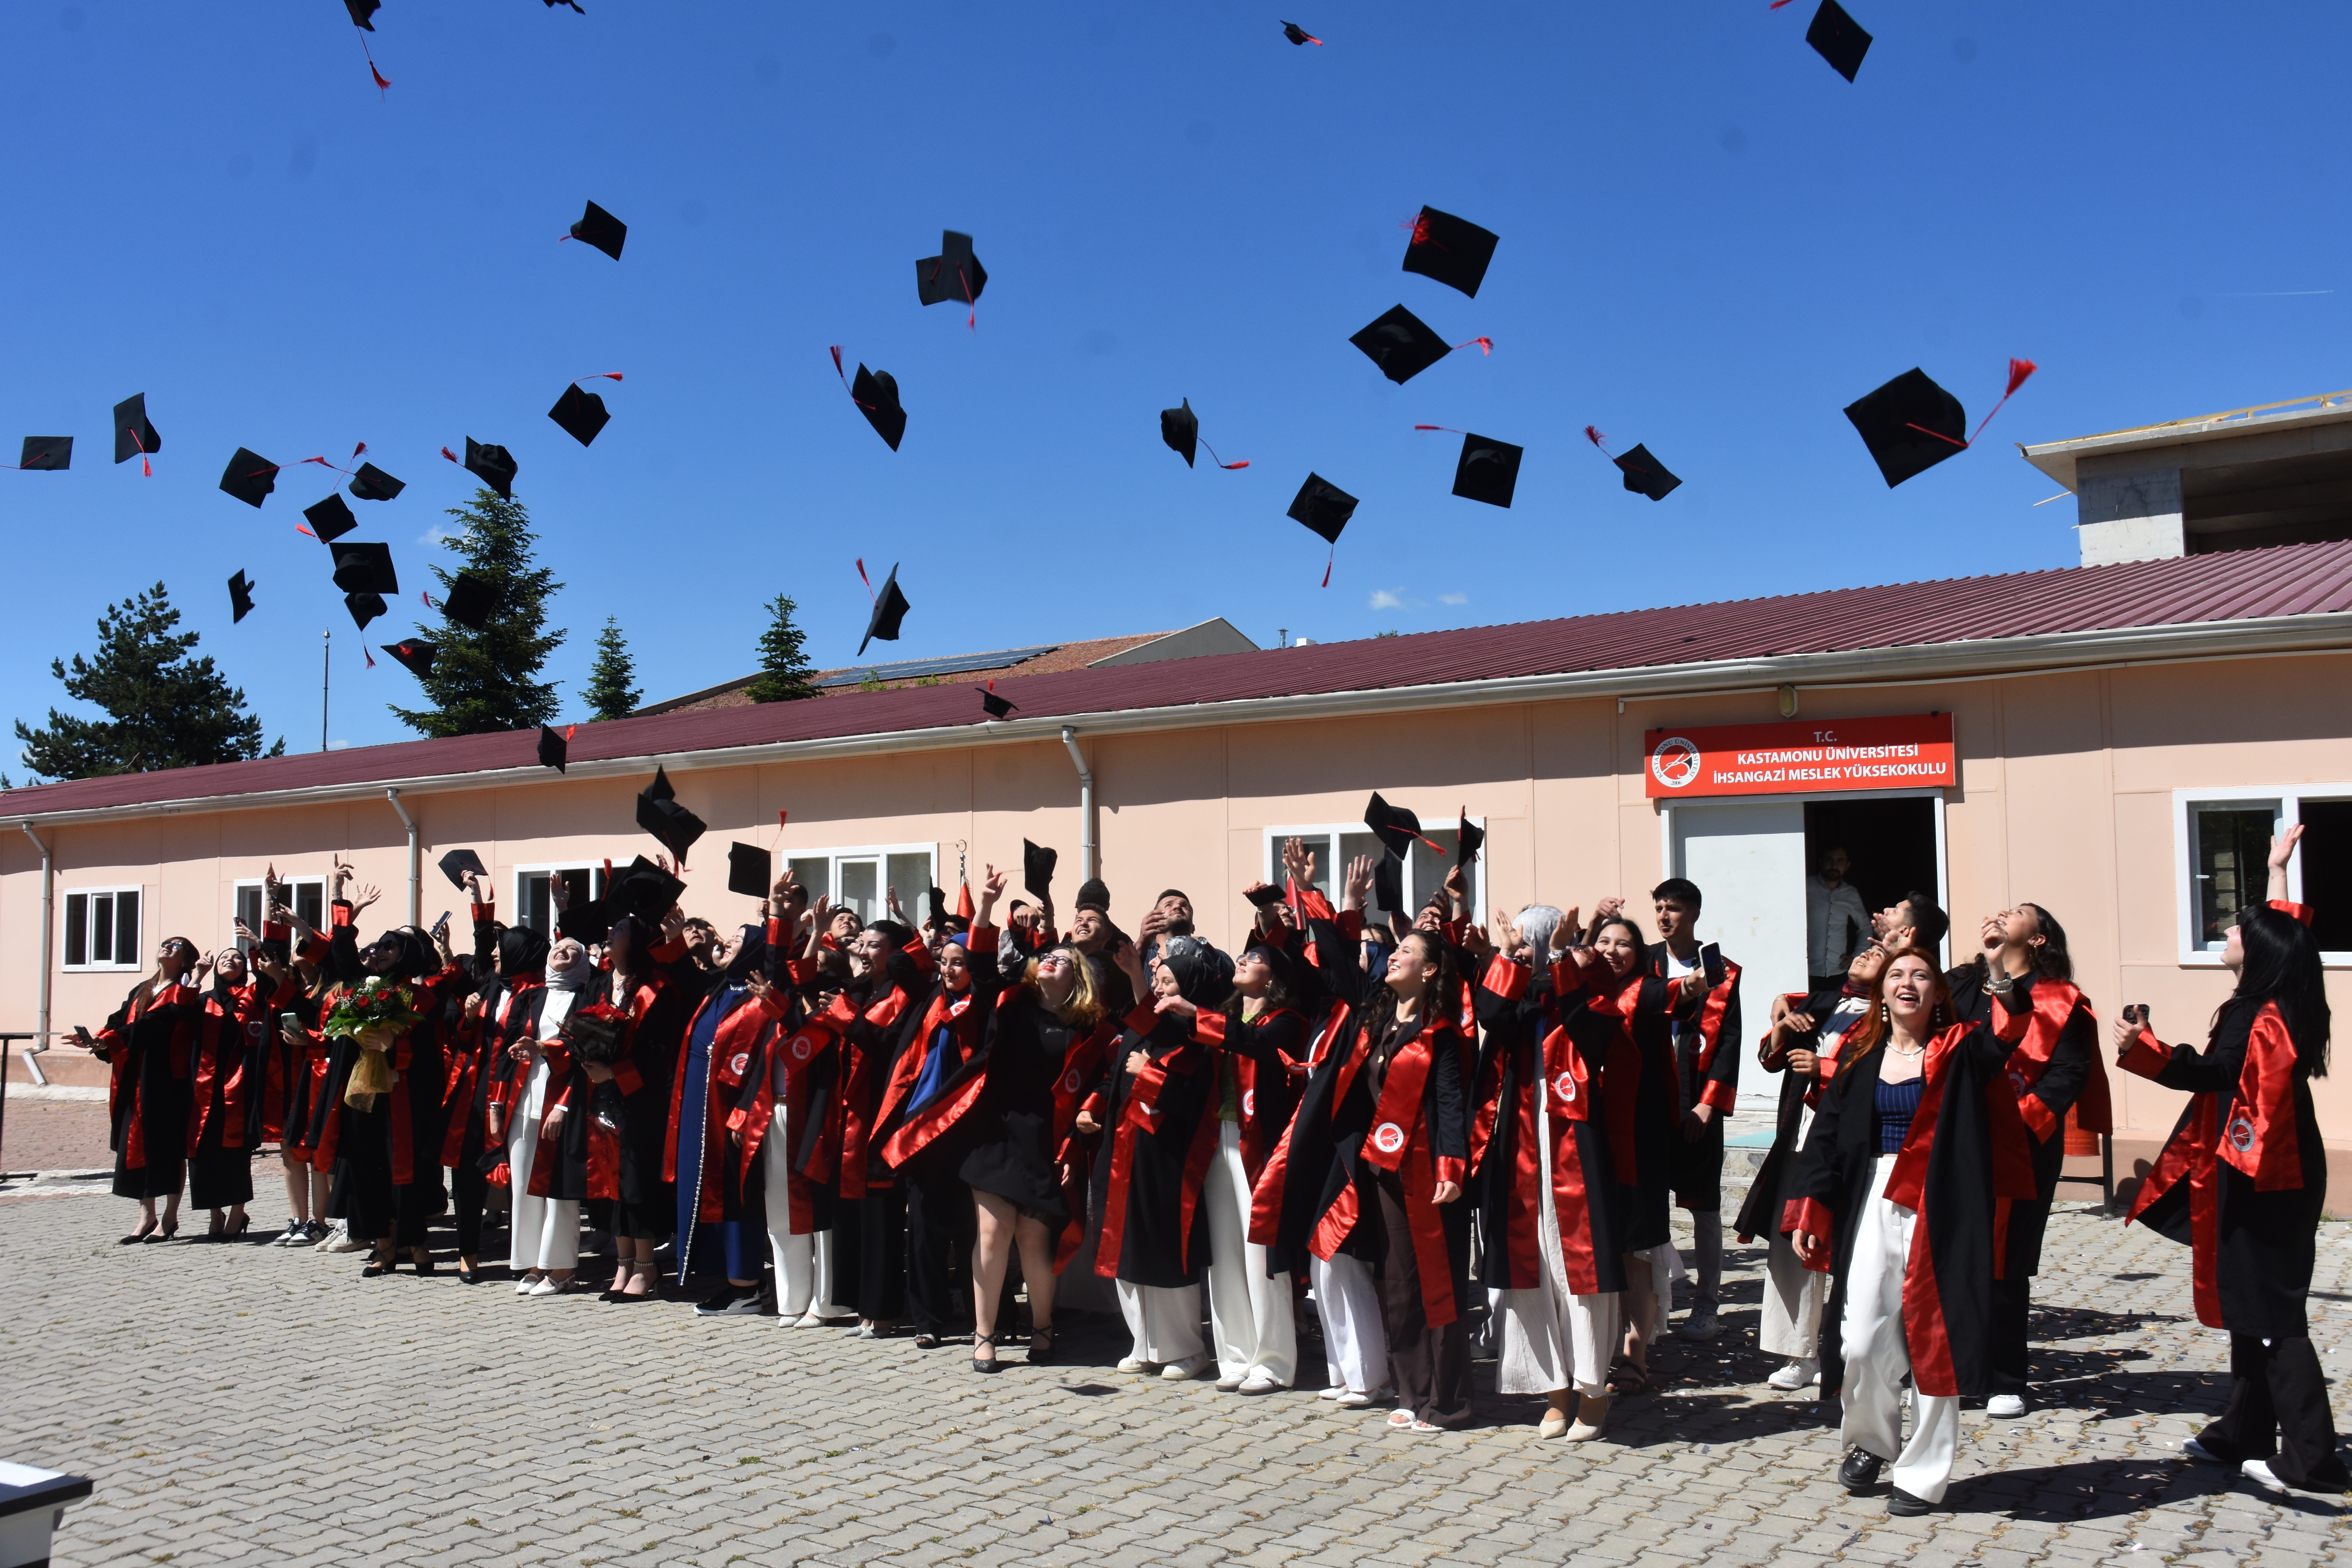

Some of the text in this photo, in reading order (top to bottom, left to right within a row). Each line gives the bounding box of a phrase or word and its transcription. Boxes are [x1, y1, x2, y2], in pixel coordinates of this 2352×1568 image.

[1814, 731, 1837, 742] T.C.
[1654, 738, 1699, 779] KASTAMONU ÜNİVERSİTESİ
[1738, 742, 1918, 764] KASTAMONU ÜNİVERSİTESİ
[1713, 762, 1946, 784] İHSANGAZİ MESLEK YÜKSEKOKULU
